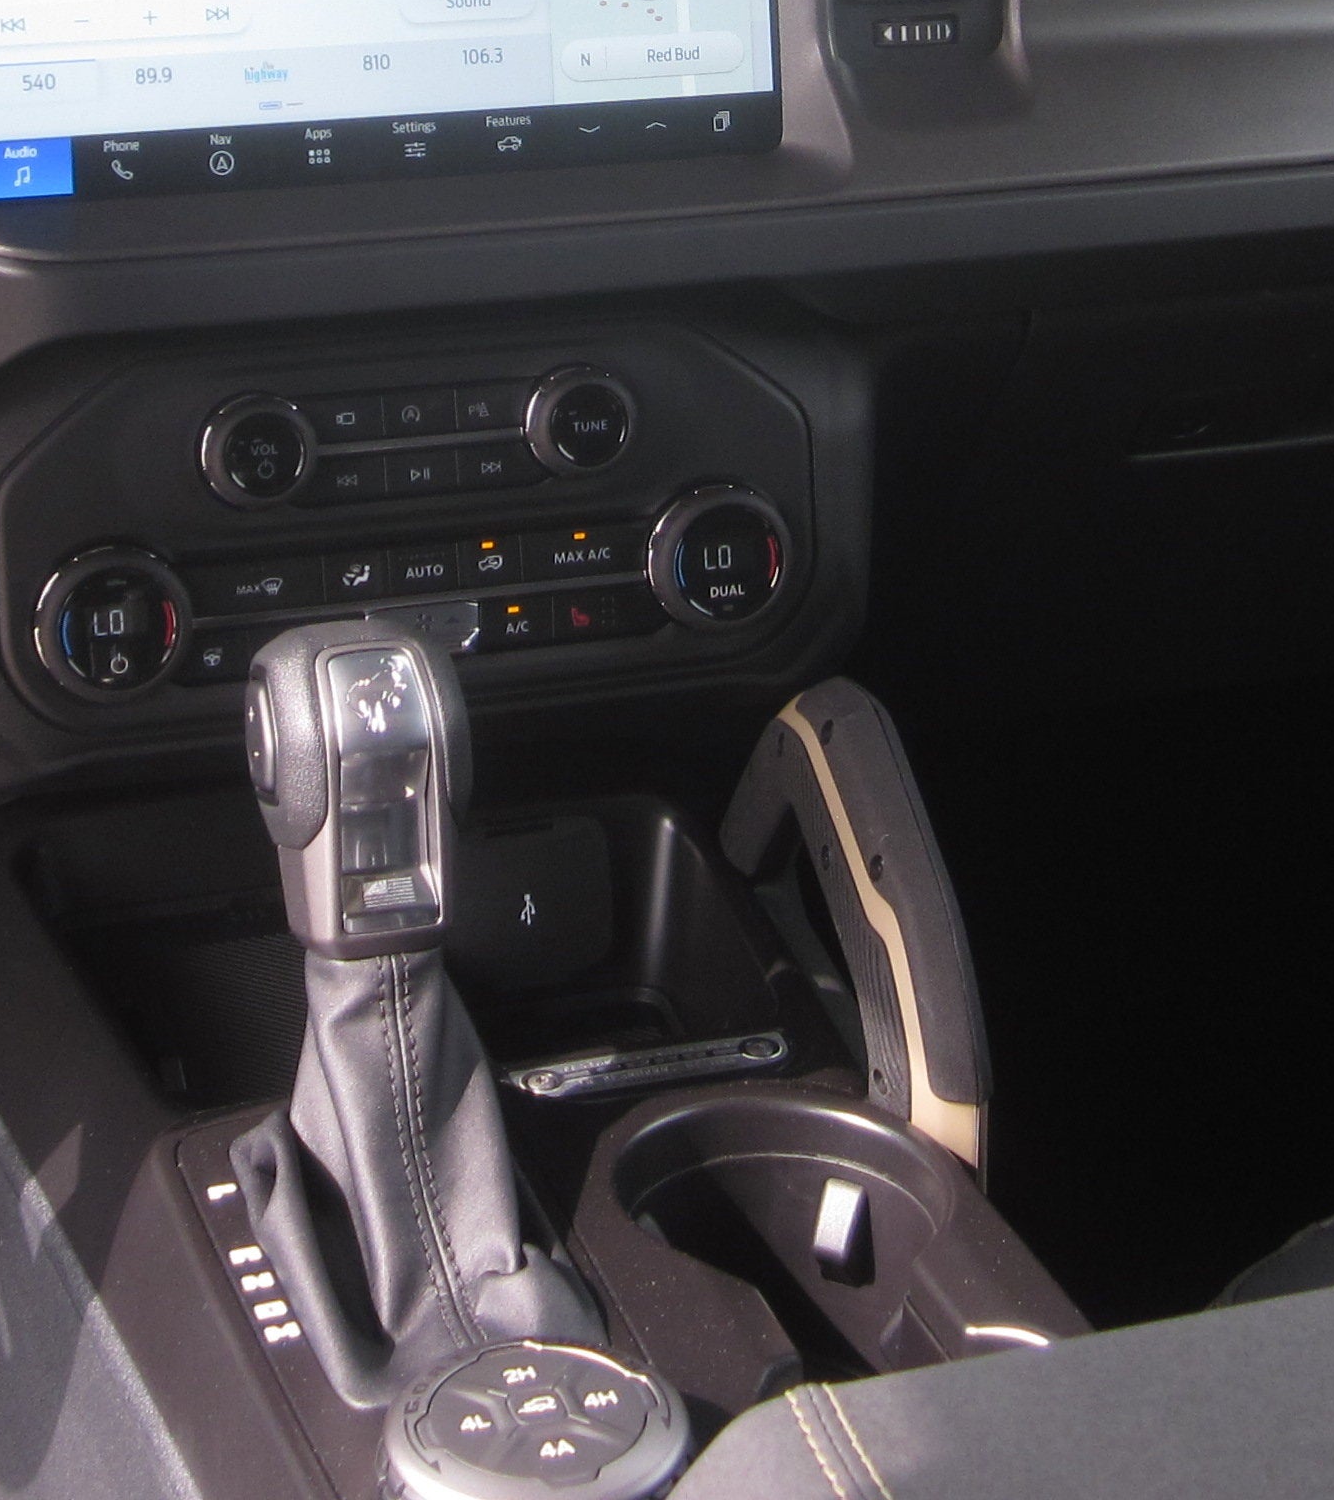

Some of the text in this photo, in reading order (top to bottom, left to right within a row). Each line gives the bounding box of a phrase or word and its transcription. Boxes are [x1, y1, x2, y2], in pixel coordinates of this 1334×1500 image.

[461, 46, 504, 65] 106.3
[580, 52, 592, 67] N
[647, 45, 700, 63] Red Bud
[362, 54, 391, 72] 810
[21, 73, 57, 92] 540
[135, 66, 173, 86] 89.9
[391, 120, 437, 135] Settings
[485, 114, 532, 128] Features
[209, 133, 232, 146] Nav
[304, 126, 333, 142] Apps
[4, 146, 38, 160] Audio
[103, 138, 140, 153] Phone
[572, 419, 609, 433] TUNE
[250, 442, 279, 456] VOL
[554, 547, 611, 565] MAX A/C
[703, 545, 732, 571] LO
[405, 564, 444, 580] AUTO
[236, 584, 261, 596] MAX
[709, 584, 746, 599] DUAL
[93, 609, 125, 637] LO
[505, 620, 530, 635] A/C
[502, 1365, 537, 1385] 2H
[583, 1389, 619, 1409] 4H
[459, 1414, 493, 1433] 4L
[539, 1439, 576, 1459] 4A
